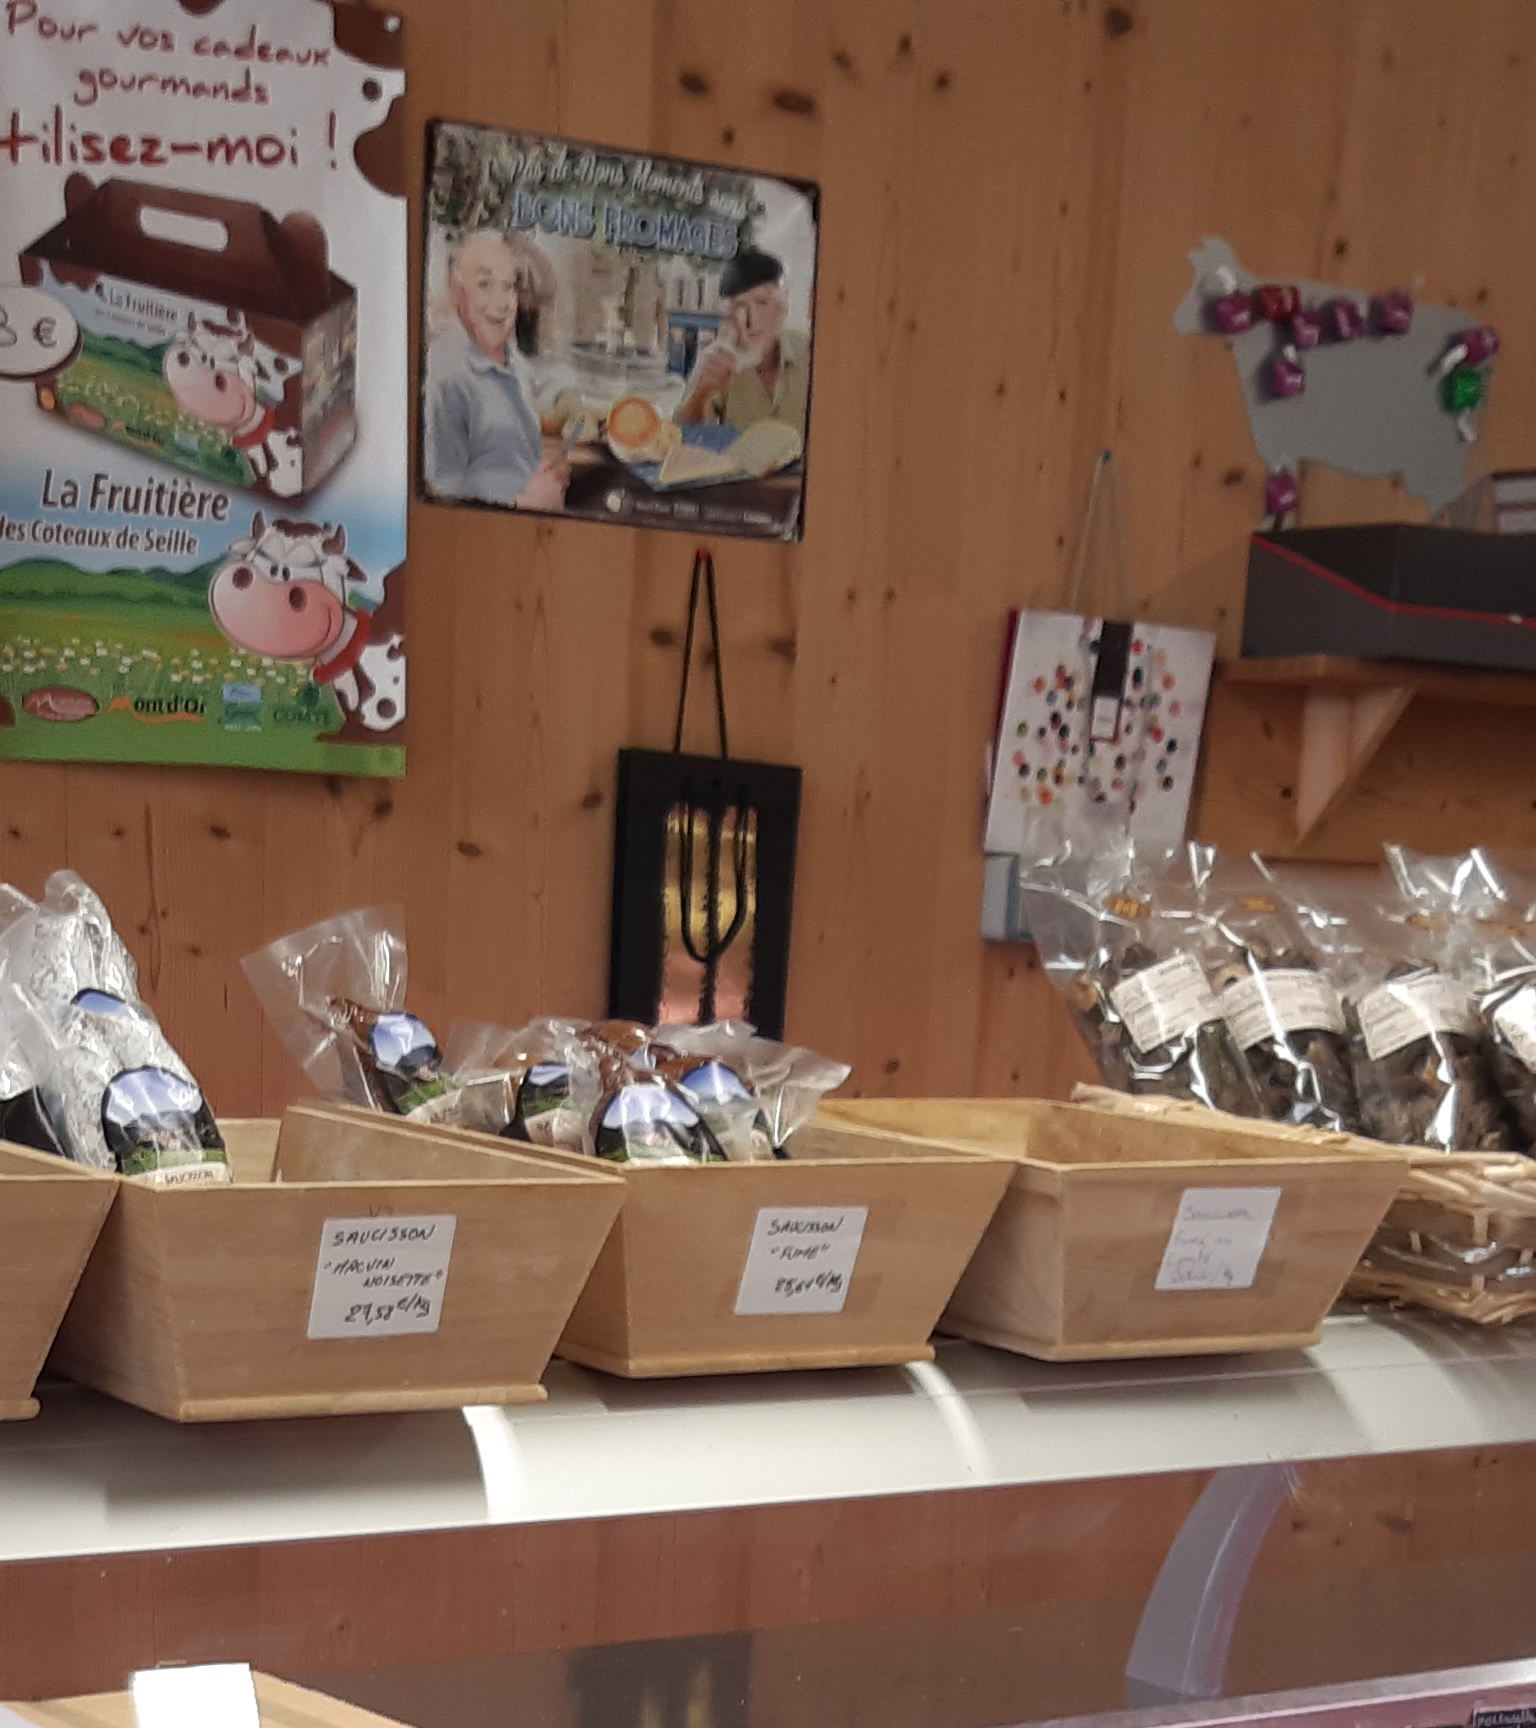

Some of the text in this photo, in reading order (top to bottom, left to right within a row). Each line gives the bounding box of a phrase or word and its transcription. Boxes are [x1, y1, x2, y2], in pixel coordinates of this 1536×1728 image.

[6, 0, 330, 66] Pour vos cadeaux
[73, 67, 270, 106] gourmands
[514, 190, 740, 260] BONS FROMAGES
[40, 467, 231, 522] La Fruitière
[30, 518, 111, 551] Coteaux
[114, 523, 141, 551] de
[143, 528, 200, 556] Seille
[331, 1223, 436, 1247] SAUCISSON
